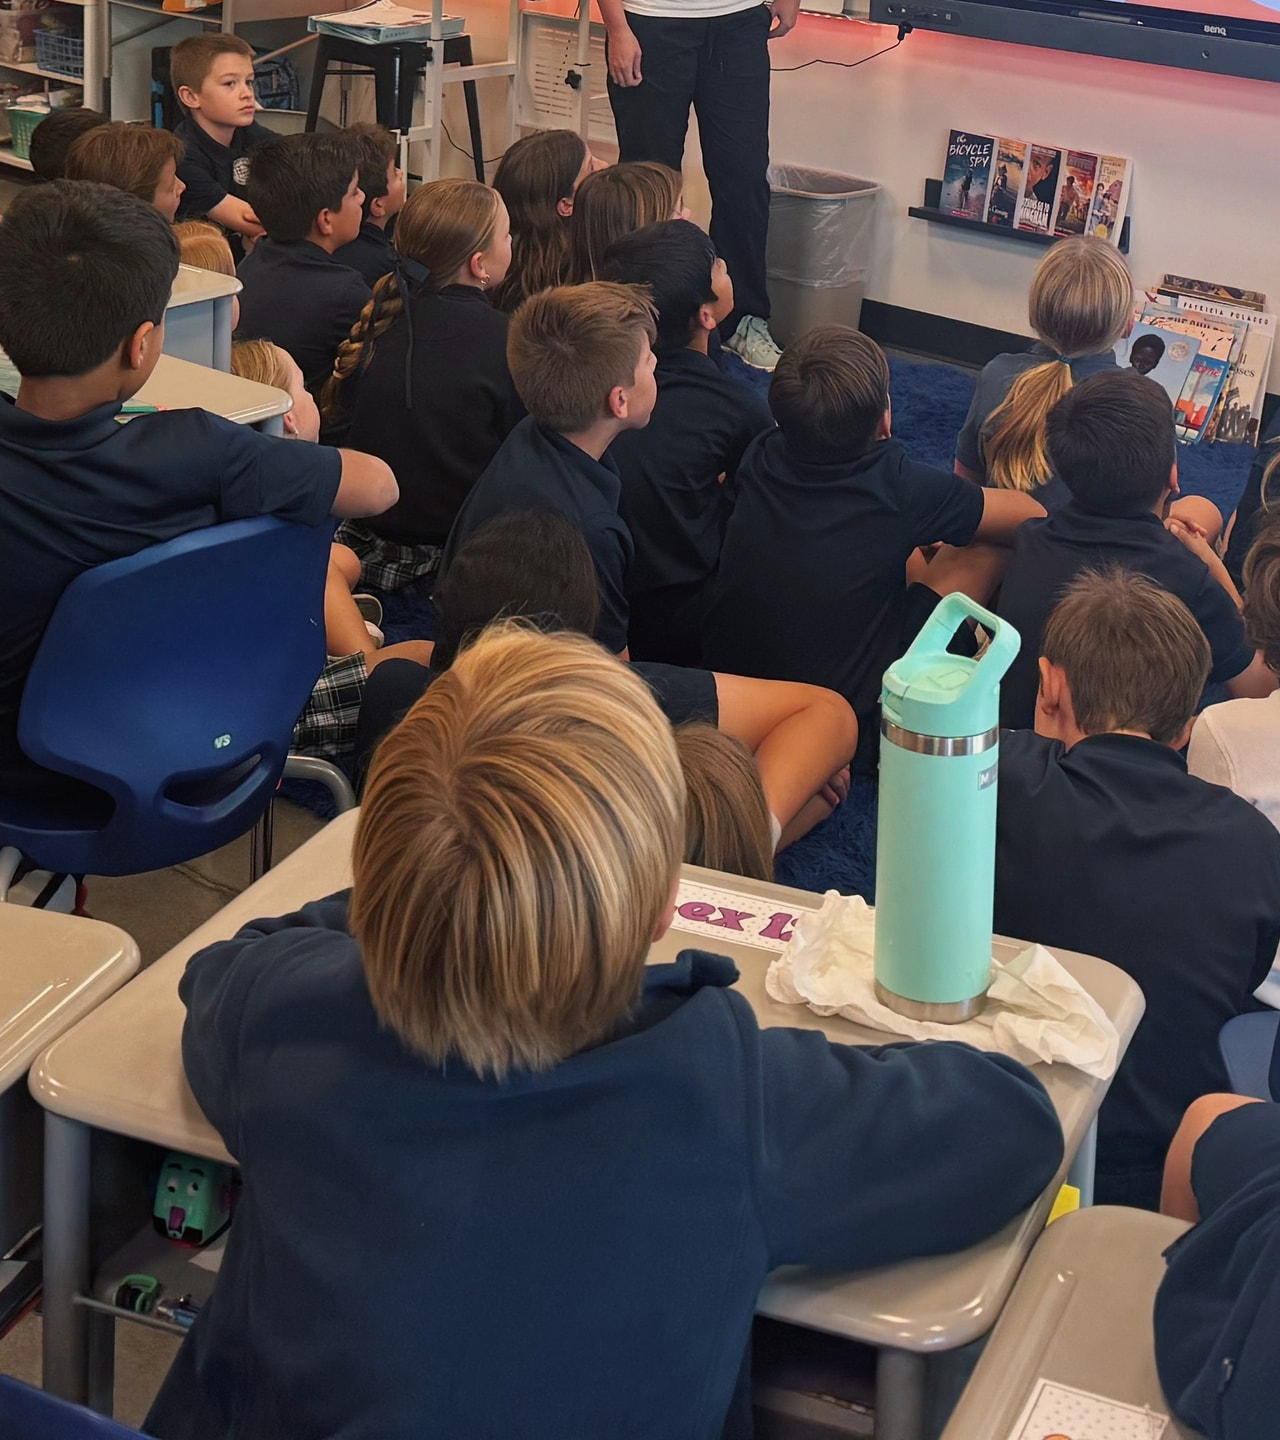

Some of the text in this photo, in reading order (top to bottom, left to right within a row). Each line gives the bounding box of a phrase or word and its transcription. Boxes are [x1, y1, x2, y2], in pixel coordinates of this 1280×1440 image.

[950, 143, 991, 156] BICYCLE
[969, 156, 990, 167] SPY
[1183, 301, 1224, 317] PATRICIA
[675, 901, 756, 932] ex
